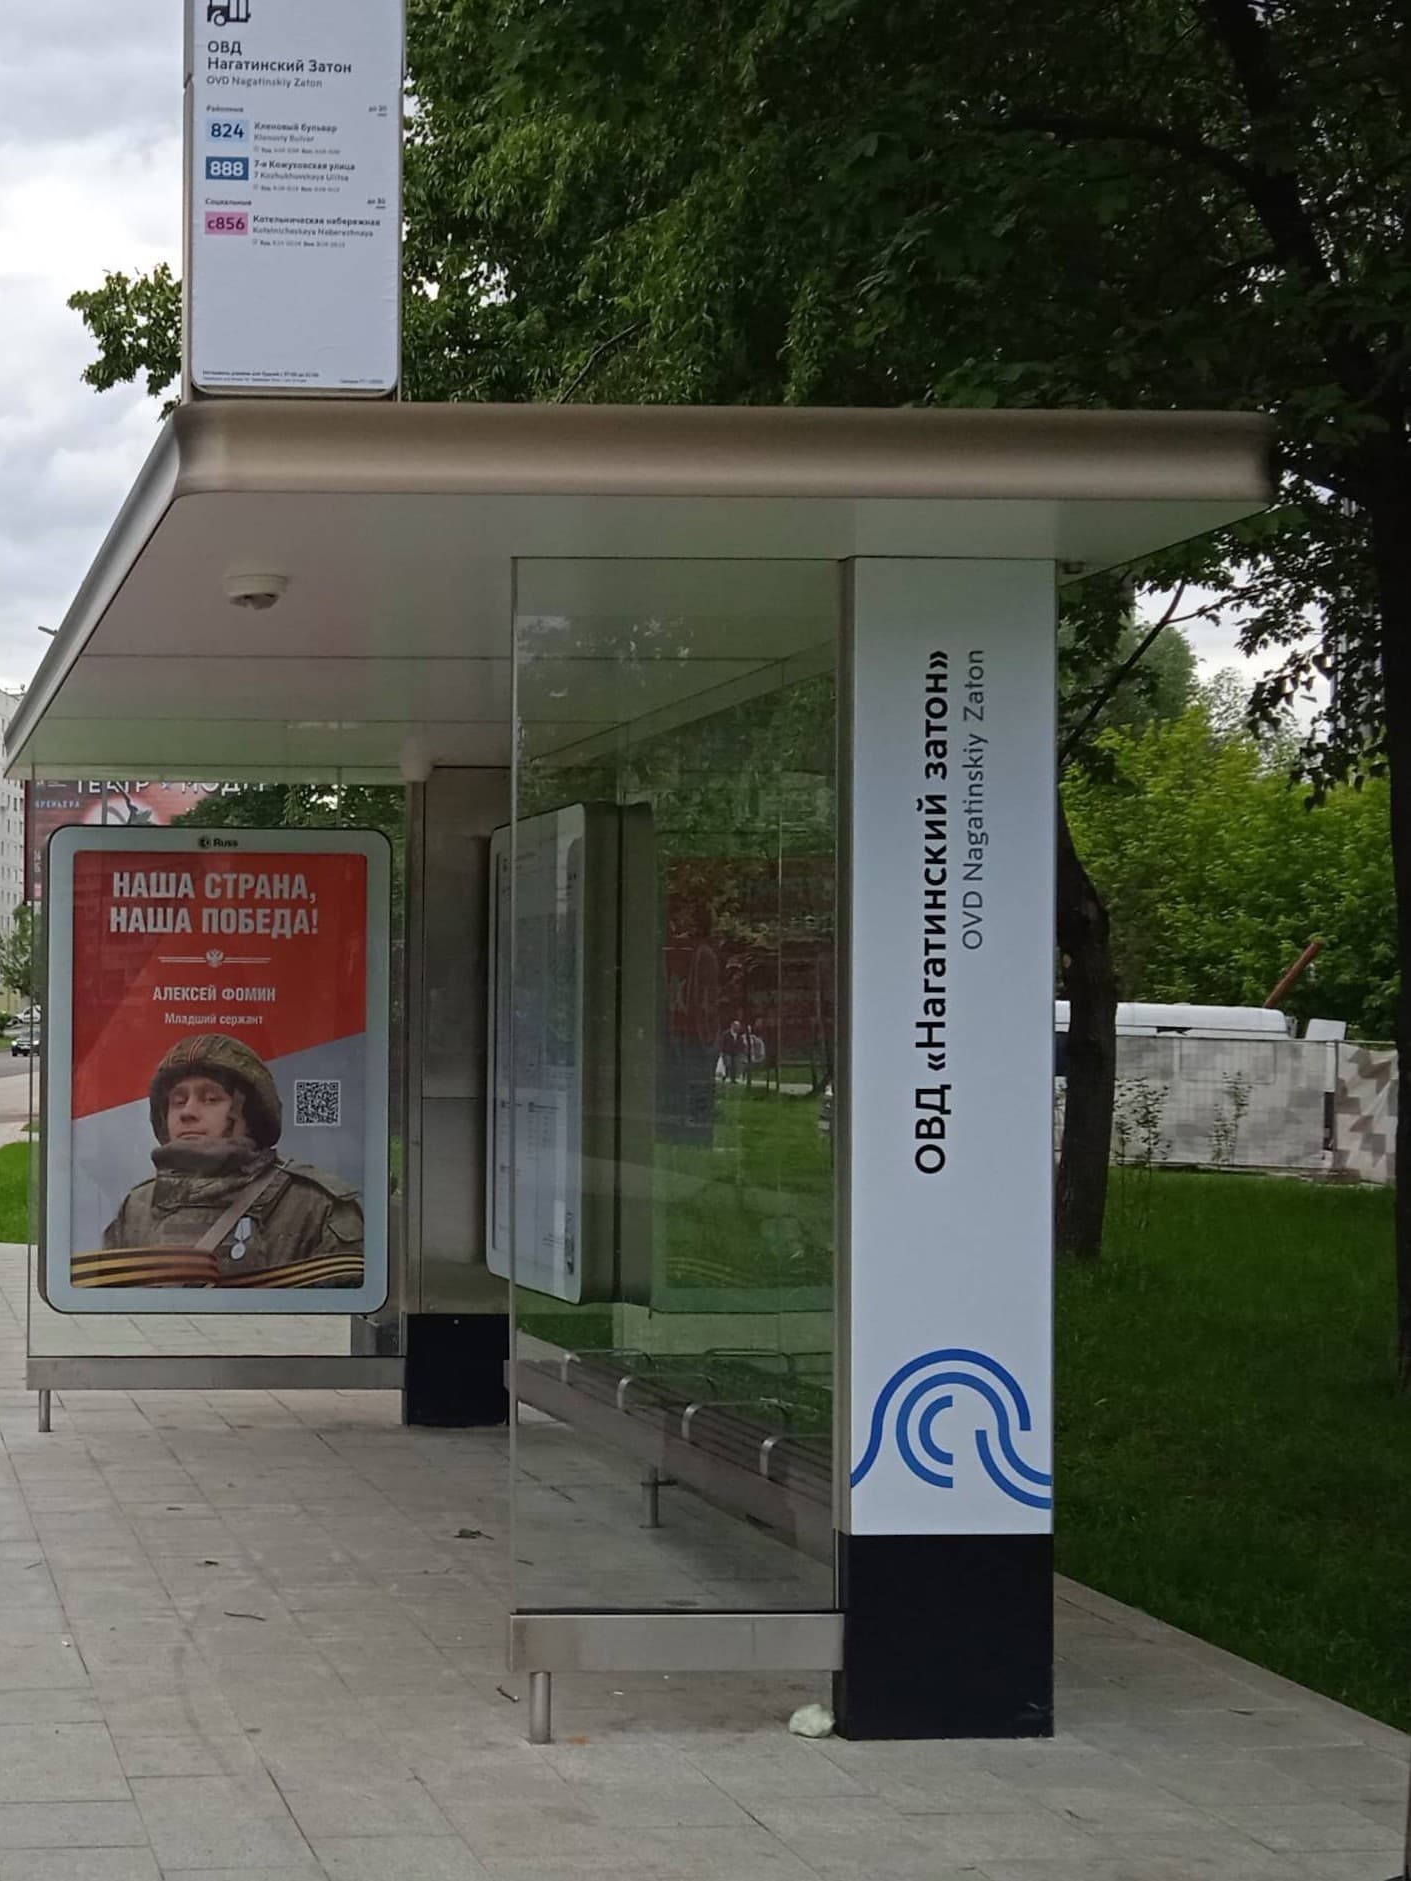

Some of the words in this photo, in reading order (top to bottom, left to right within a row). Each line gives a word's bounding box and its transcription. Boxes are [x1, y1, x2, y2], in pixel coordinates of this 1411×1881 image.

[207, 40, 242, 55] ОВД
[207, 57, 304, 72] Нагатинский
[308, 59, 352, 73] Затон
[206, 76, 229, 85] OVD
[231, 76, 291, 88] Nagatinskiy
[294, 77, 323, 87] Zaton
[210, 122, 245, 138] 824
[209, 161, 244, 177] 888
[269, 160, 328, 171] Кожуховская
[207, 216, 246, 231] с856
[253, 215, 325, 225] Котельническая
[326, 217, 381, 227] набережная
[962, 648, 984, 722] Zaton
[925, 650, 949, 780] затон»
[962, 734, 989, 881] Nagatinskiy
[213, 838, 238, 847] Russ
[113, 871, 195, 899] НАША
[204, 873, 317, 903] СТРАНА,
[110, 906, 192, 934] НАША
[202, 908, 319, 939] ПОБЕДА!
[962, 890, 983, 950] OVD
[915, 795, 948, 1072] «Нагатинский
[153, 984, 216, 1001] АЛЕКСЕЙ
[222, 986, 276, 1002] ФОМИН
[164, 1012, 216, 1026] Младший
[219, 1014, 263, 1026] сержант
[915, 1083, 951, 1174] ОВД
